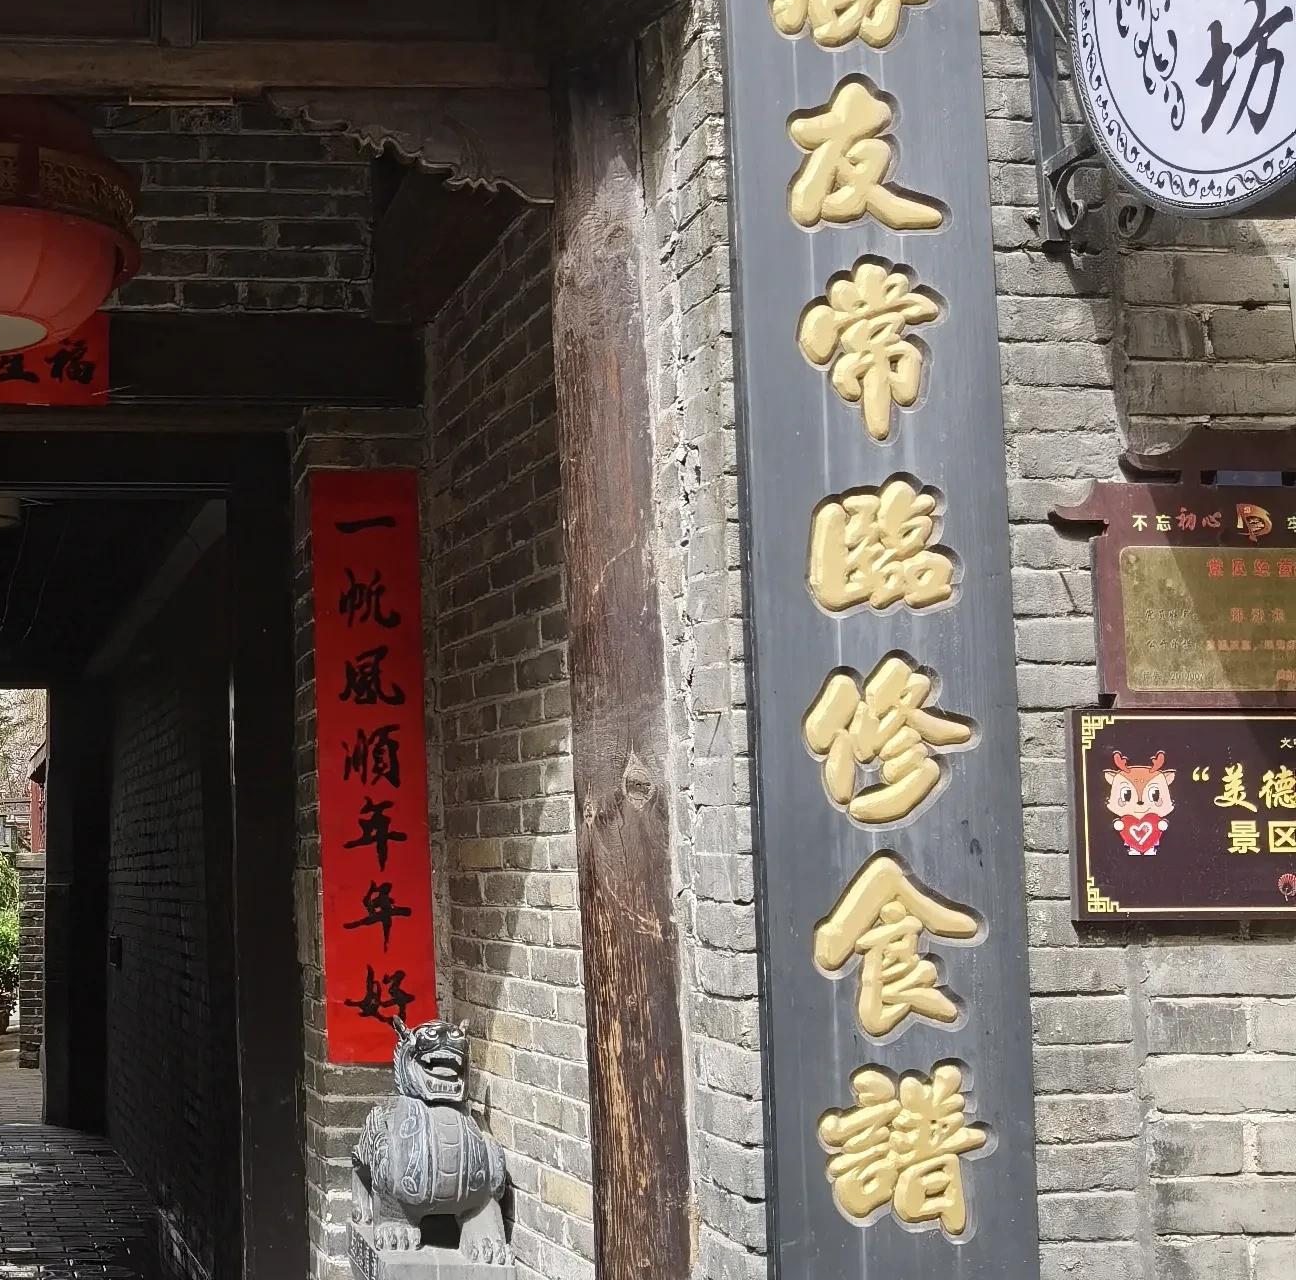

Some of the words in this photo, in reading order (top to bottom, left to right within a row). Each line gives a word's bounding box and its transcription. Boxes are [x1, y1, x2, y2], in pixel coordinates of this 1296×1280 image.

[1132, 506, 1222, 532] 不忘初心
[1280, 737, 1296, 749] 文
[1226, 820, 1296, 854] 景区
